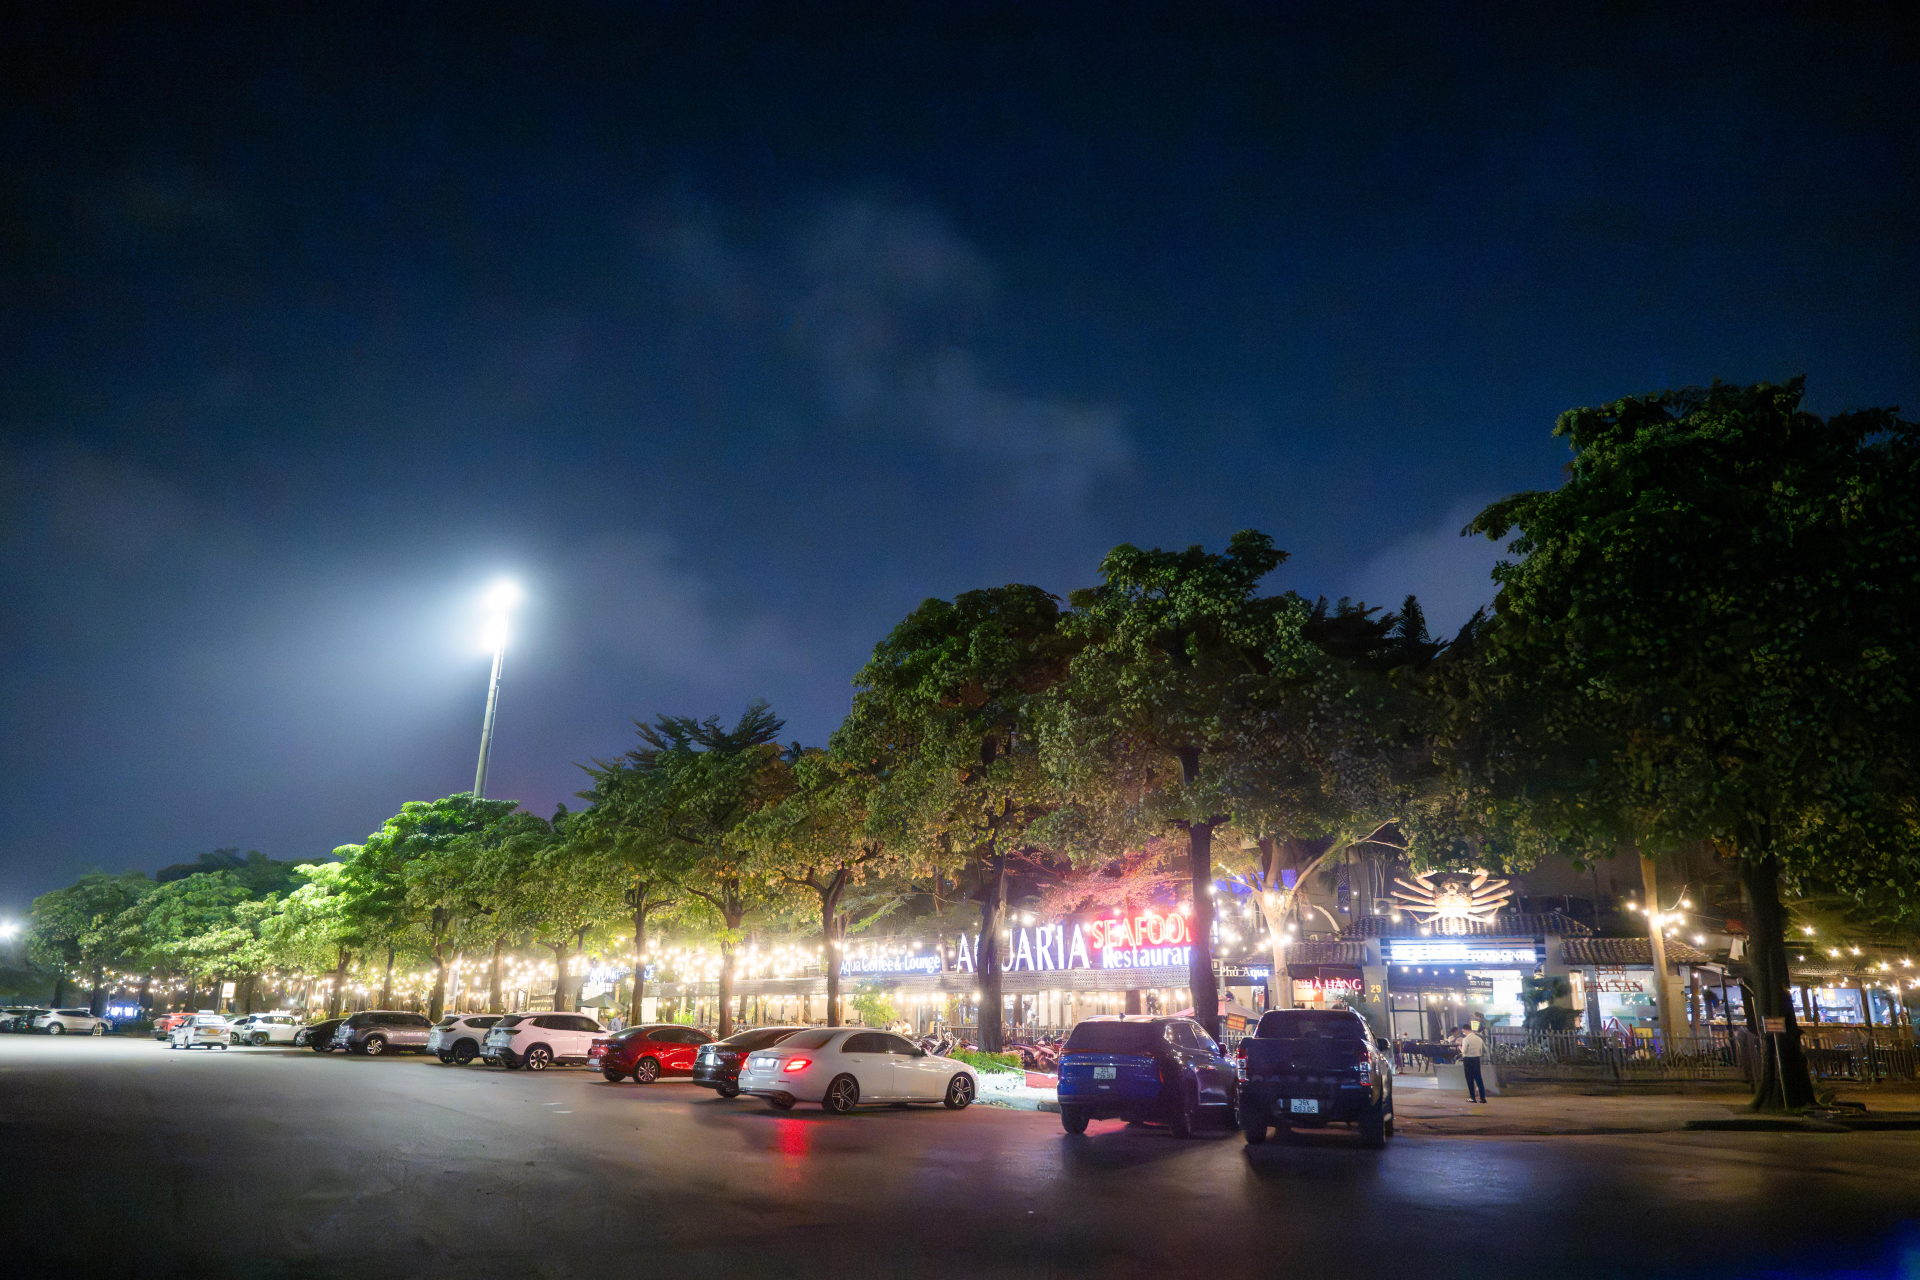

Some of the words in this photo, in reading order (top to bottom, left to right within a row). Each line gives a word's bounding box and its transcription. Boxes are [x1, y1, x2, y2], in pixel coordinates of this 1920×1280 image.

[957, 924, 1090, 973] AUARIA
[1103, 945, 1191, 968] Restauran
[840, 960, 860, 976] Aqua
[862, 956, 894, 972] Coffee
[894, 956, 902, 971] &
[904, 955, 940, 973] Lounge
[1220, 965, 1239, 977] Phở
[1242, 967, 1269, 980] Aqua
[1296, 976, 1322, 990] NHÀ
[1325, 977, 1362, 990] HÀNG
[1370, 985, 1382, 994] 29
[1373, 994, 1381, 1003] A
